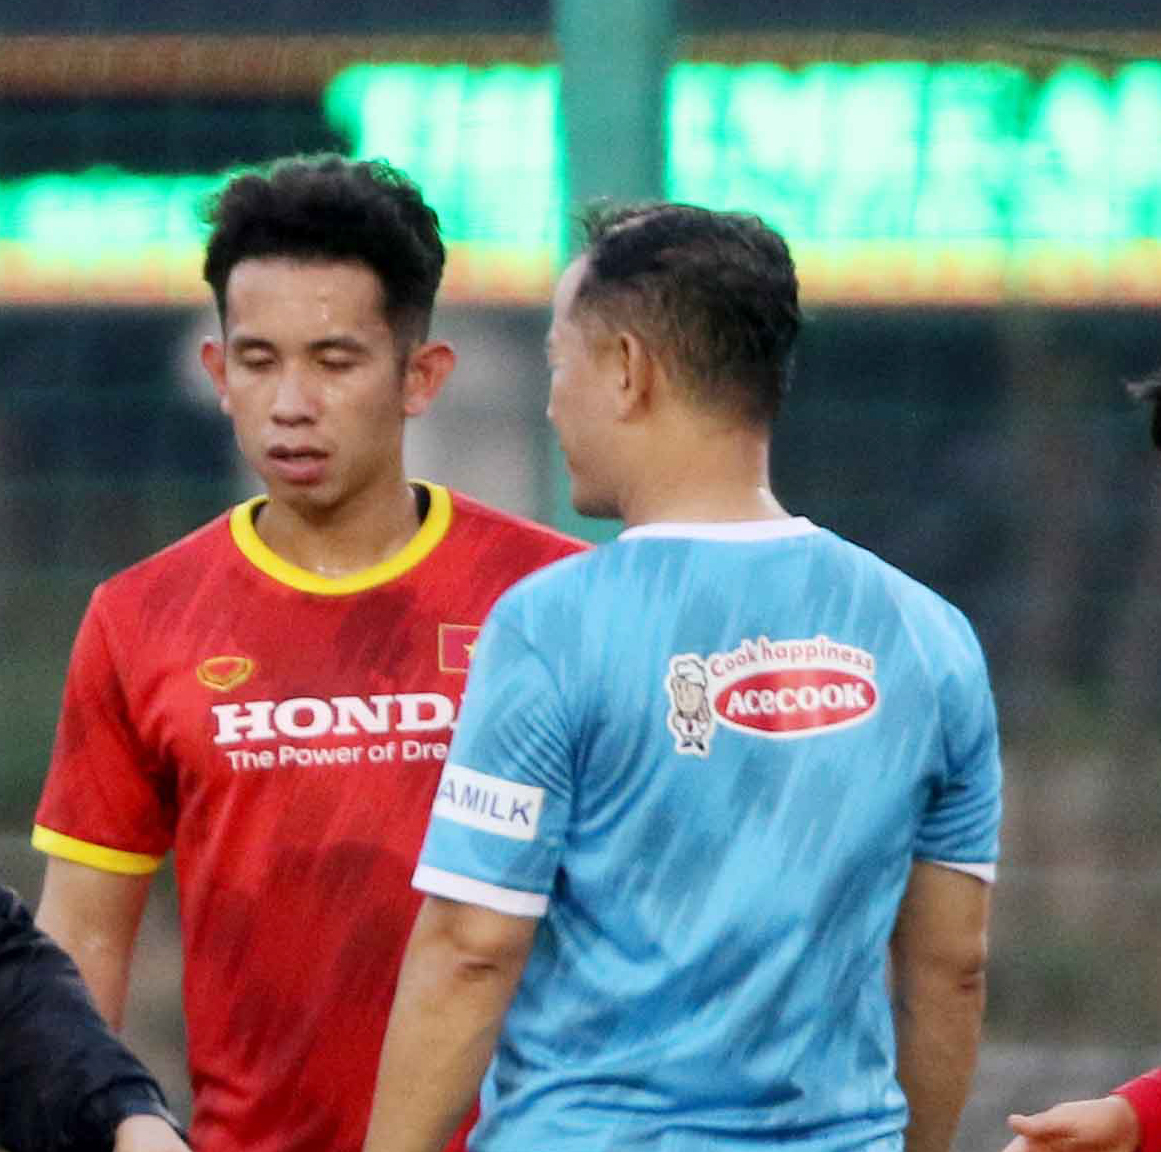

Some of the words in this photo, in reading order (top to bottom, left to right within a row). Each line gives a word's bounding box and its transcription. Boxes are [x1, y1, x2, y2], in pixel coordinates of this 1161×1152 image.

[709, 641, 757, 677] Cook
[760, 637, 874, 671] happiness
[211, 692, 466, 745] HOND
[226, 750, 276, 771] The
[278, 745, 361, 766] Power
[367, 740, 397, 763] of
